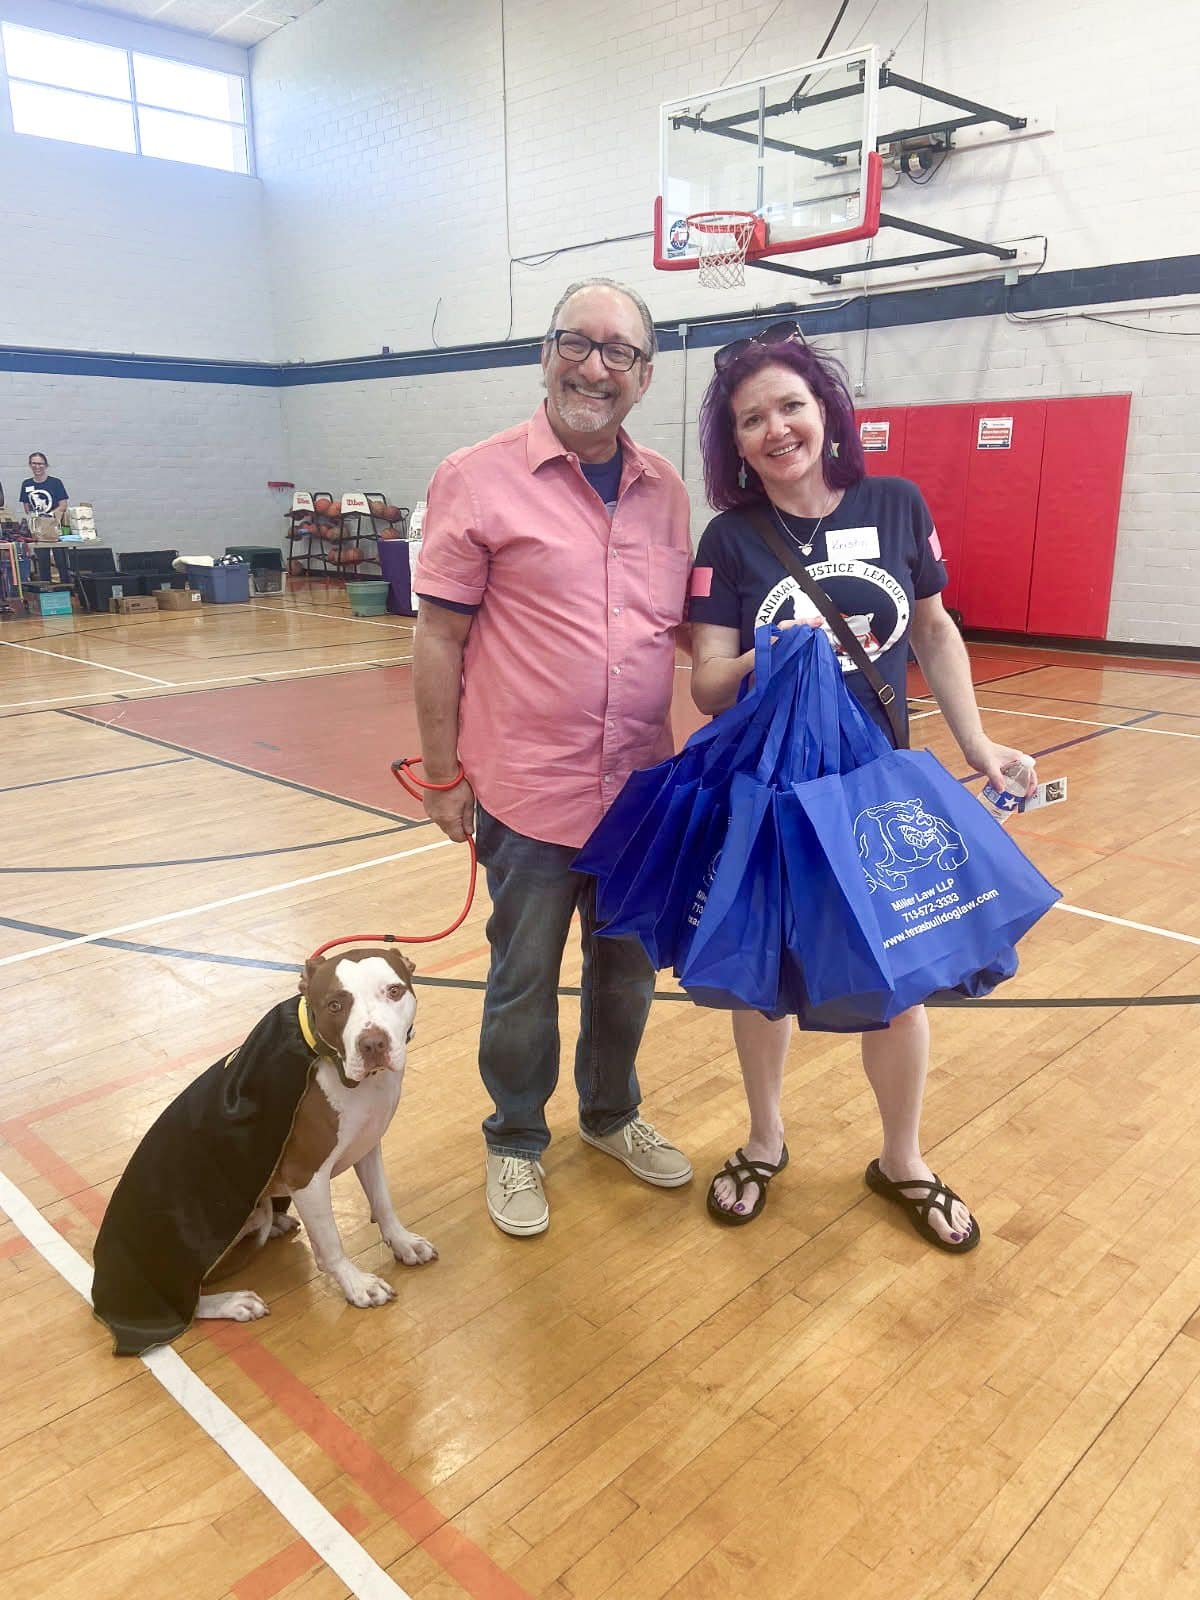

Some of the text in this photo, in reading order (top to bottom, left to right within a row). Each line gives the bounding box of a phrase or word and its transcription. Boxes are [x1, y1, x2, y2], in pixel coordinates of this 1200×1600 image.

[759, 563, 906, 623] ANIMAL USTICE LEAGUE
[891, 878, 955, 911] Miller Law LLP
[901, 892, 960, 922] 713-572-3333
[882, 888, 999, 949] www.texasbulldoglaw.com
